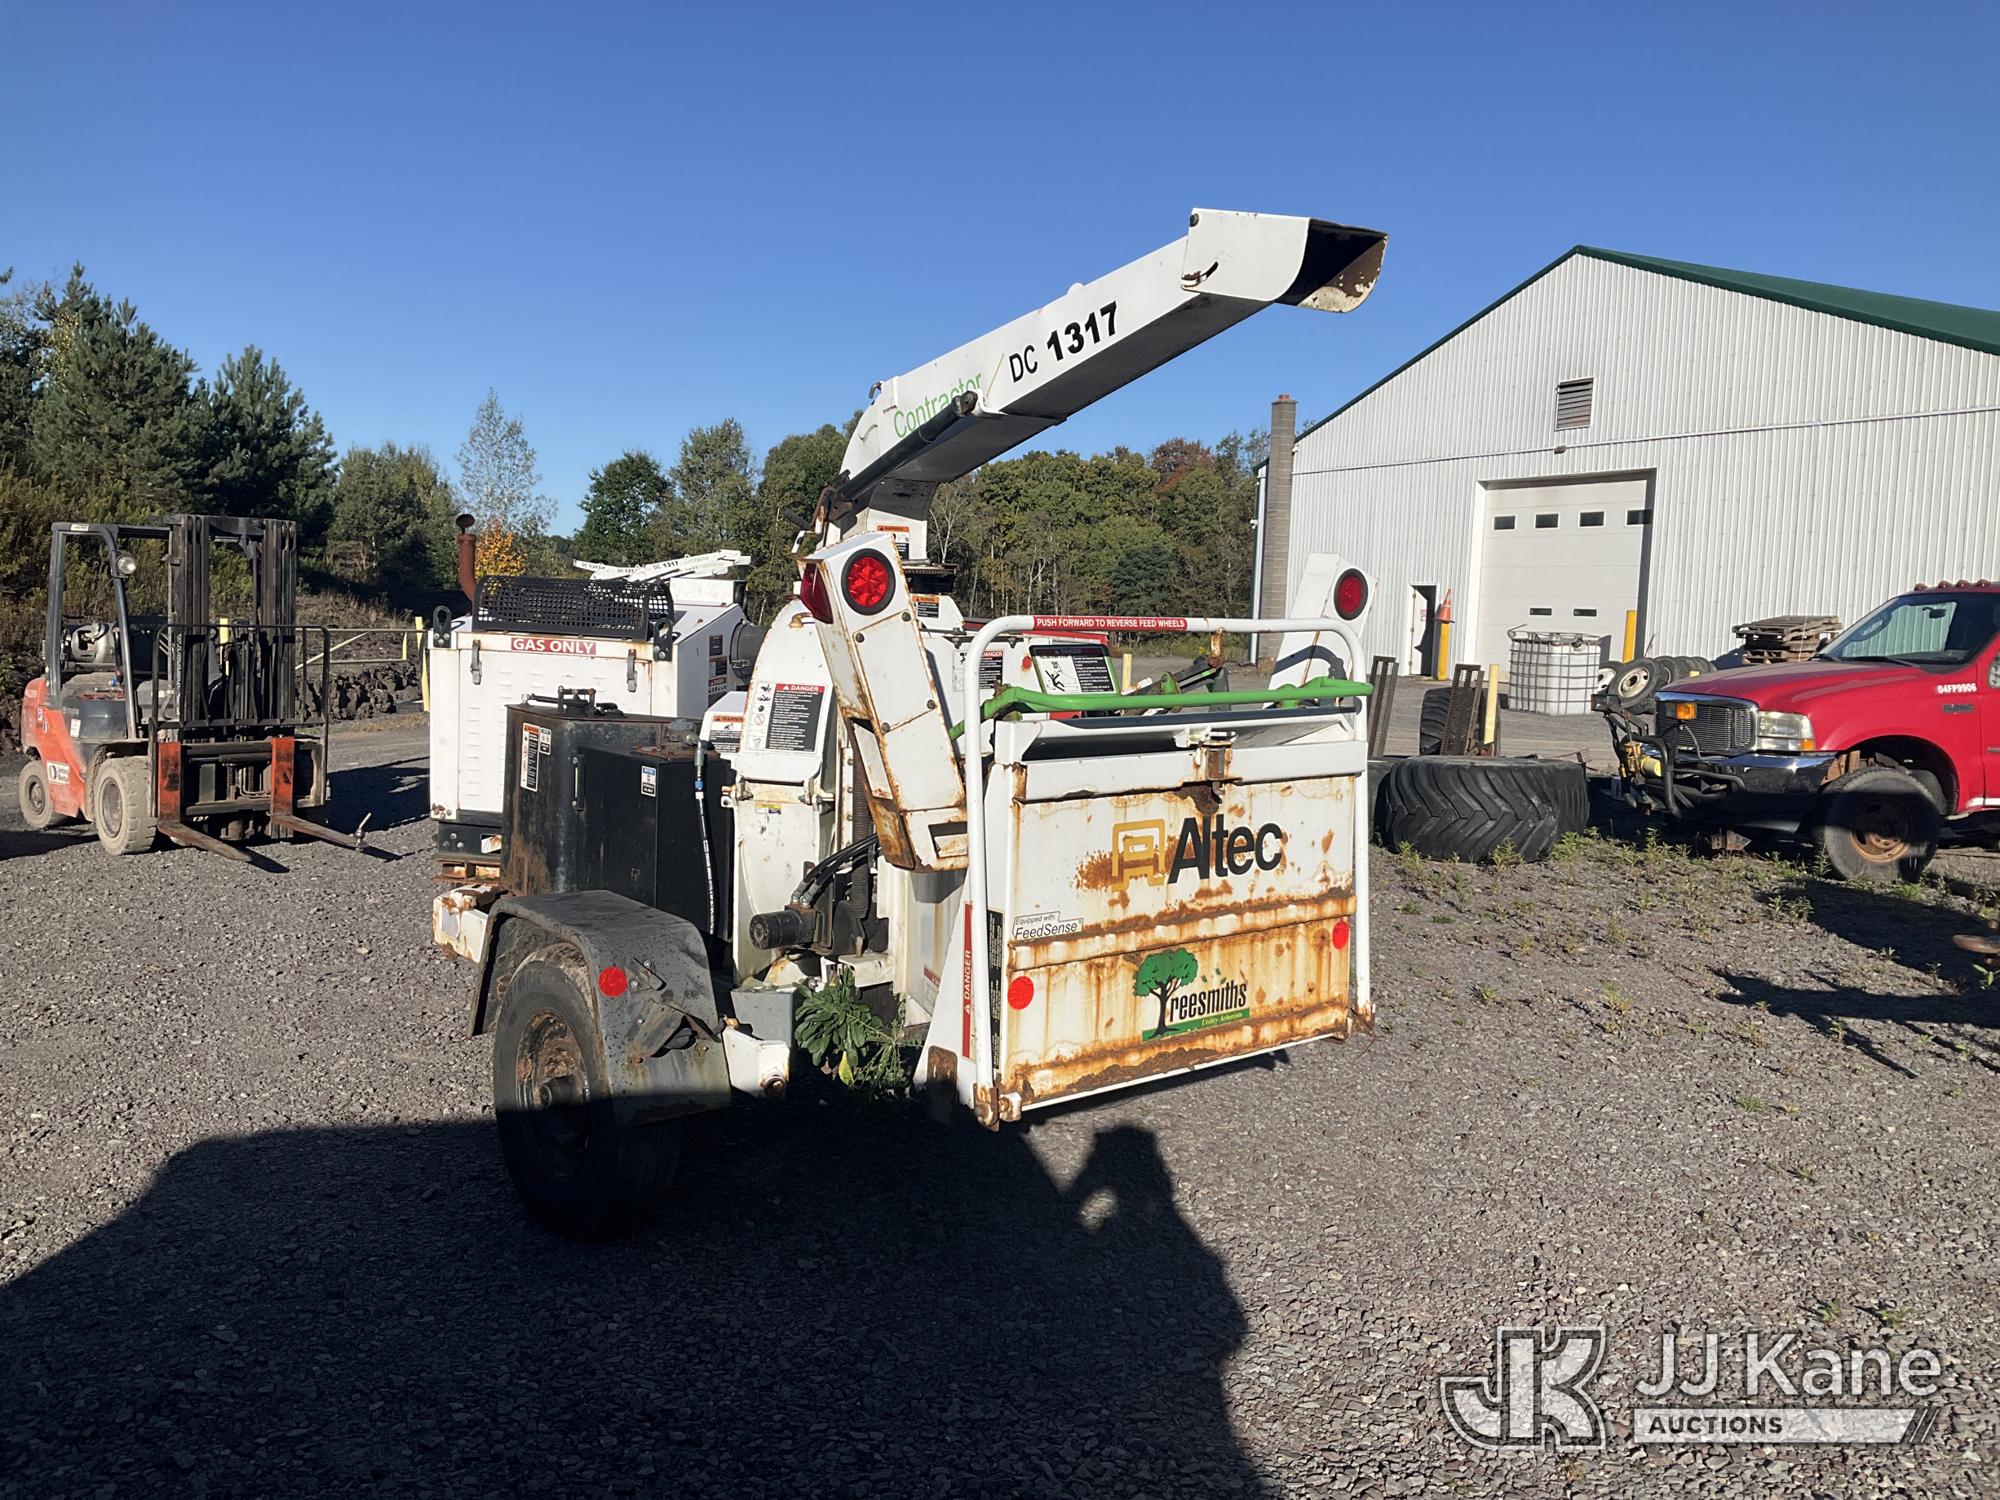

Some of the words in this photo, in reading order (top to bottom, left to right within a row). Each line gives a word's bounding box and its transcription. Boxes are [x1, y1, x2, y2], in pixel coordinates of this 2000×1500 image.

[1008, 344, 1039, 384] DC
[1046, 300, 1118, 362] 1317
[1036, 618, 1057, 627] PUSH
[1058, 618, 1095, 627] FORWARD
[1095, 618, 1106, 627] TO
[1106, 618, 1138, 628] REVERSE
[1139, 619, 1157, 628] FEED
[1158, 619, 1185, 628] WHEELS
[513, 638, 546, 651] GAS
[549, 640, 594, 654] ONLY
[1937, 683, 1977, 694] 04FP9906
[1167, 813, 1283, 885] Altec
[1015, 916, 1042, 925] Equipped
[963, 950, 972, 1001] DANGER
